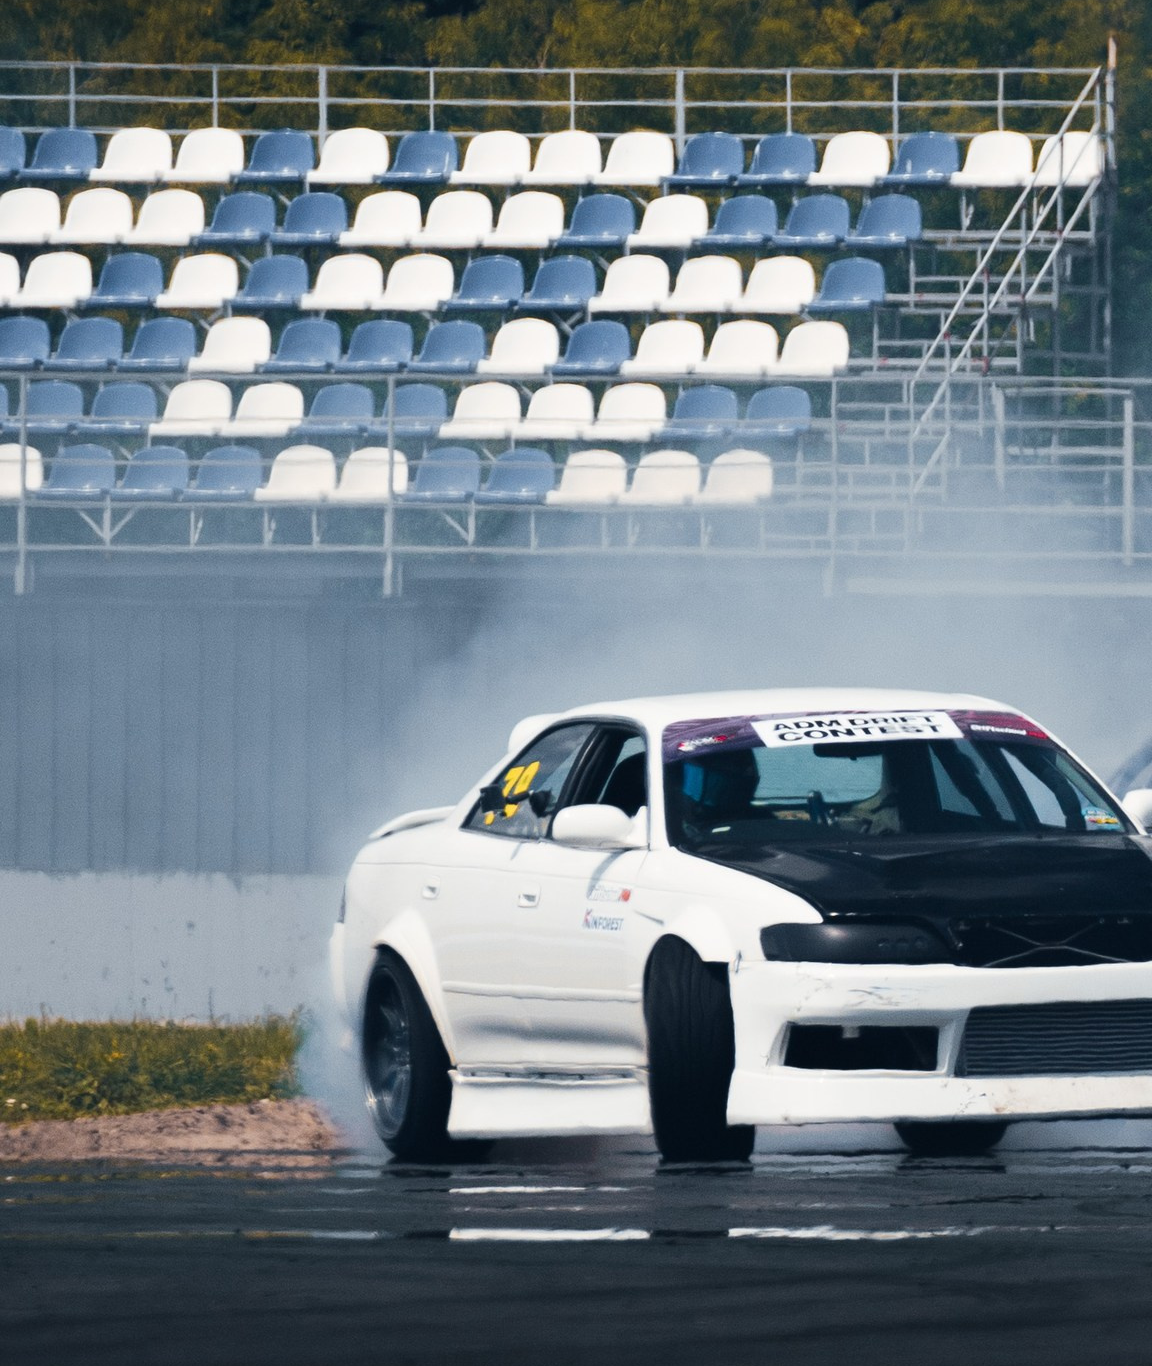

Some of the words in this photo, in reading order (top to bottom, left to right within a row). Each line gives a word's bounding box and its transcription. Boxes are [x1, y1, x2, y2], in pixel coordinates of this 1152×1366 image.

[773, 718, 842, 731] ADM
[848, 715, 935, 726] DRIFT
[778, 723, 944, 742] CONTEST
